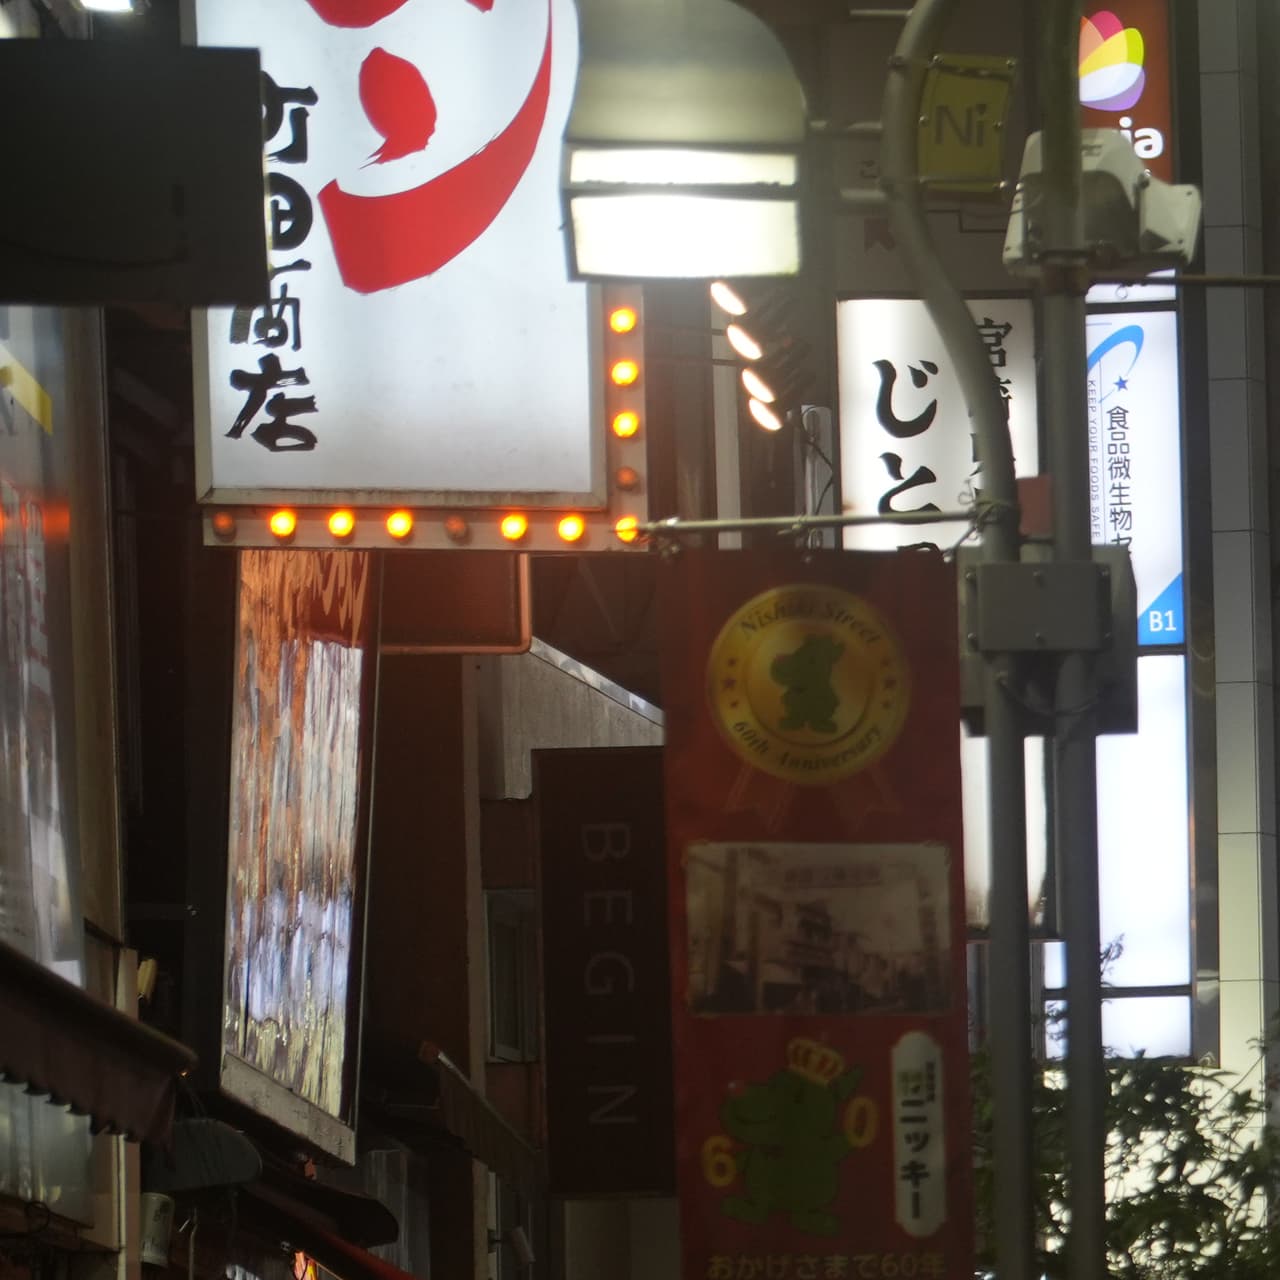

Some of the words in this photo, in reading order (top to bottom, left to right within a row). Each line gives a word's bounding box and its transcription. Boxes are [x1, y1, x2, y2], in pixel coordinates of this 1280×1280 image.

[872, 359, 942, 550] じと
[1149, 608, 1178, 632] B1
[579, 823, 639, 1125] BEGIN
